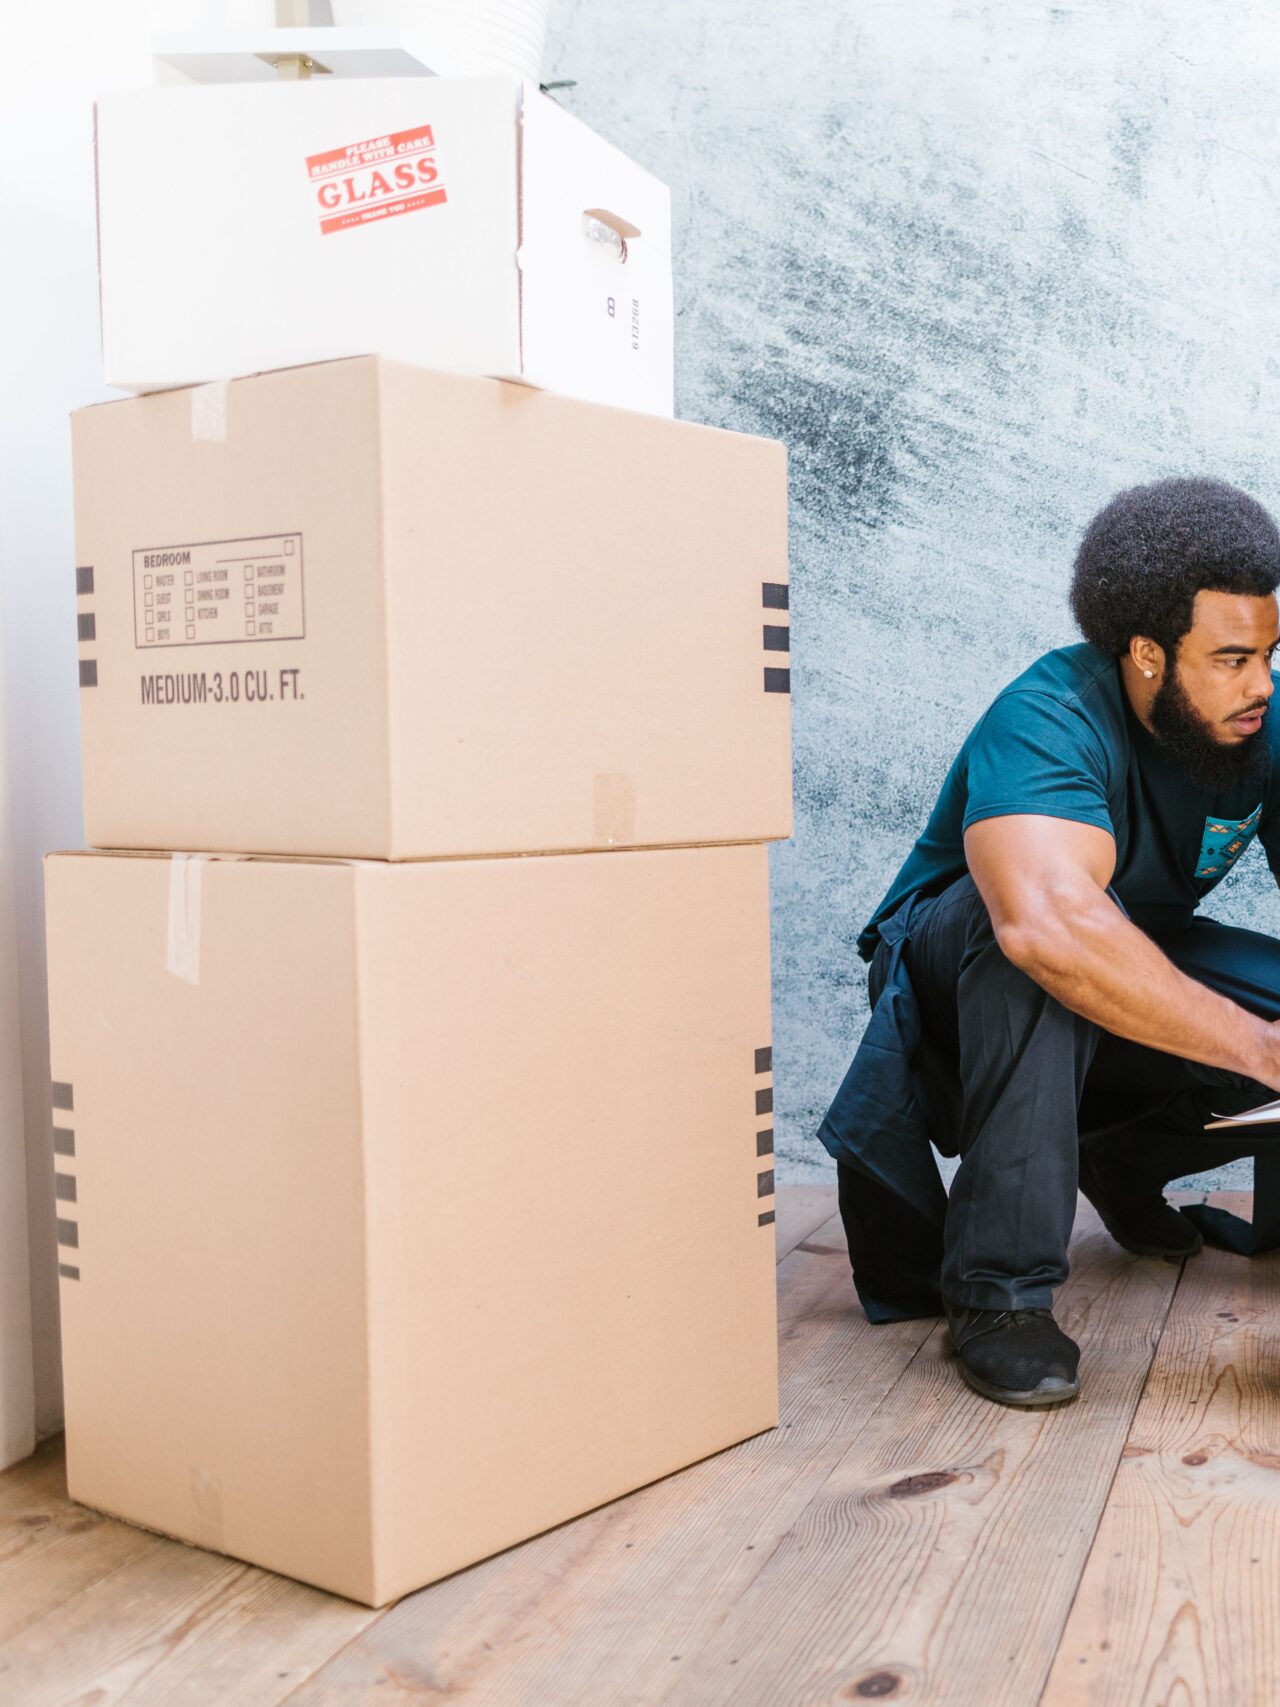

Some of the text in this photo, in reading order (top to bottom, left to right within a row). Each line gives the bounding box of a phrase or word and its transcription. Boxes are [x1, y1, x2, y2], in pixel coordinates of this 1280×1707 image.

[311, 136, 431, 177] HANDLE WITH CARE
[346, 137, 392, 157] PLEASE
[317, 157, 438, 209] GLASS
[361, 203, 407, 221] THANK YOU
[144, 551, 191, 568] BEDROOM
[141, 668, 305, 705] MEDIUM-3.0 CU. FT.
